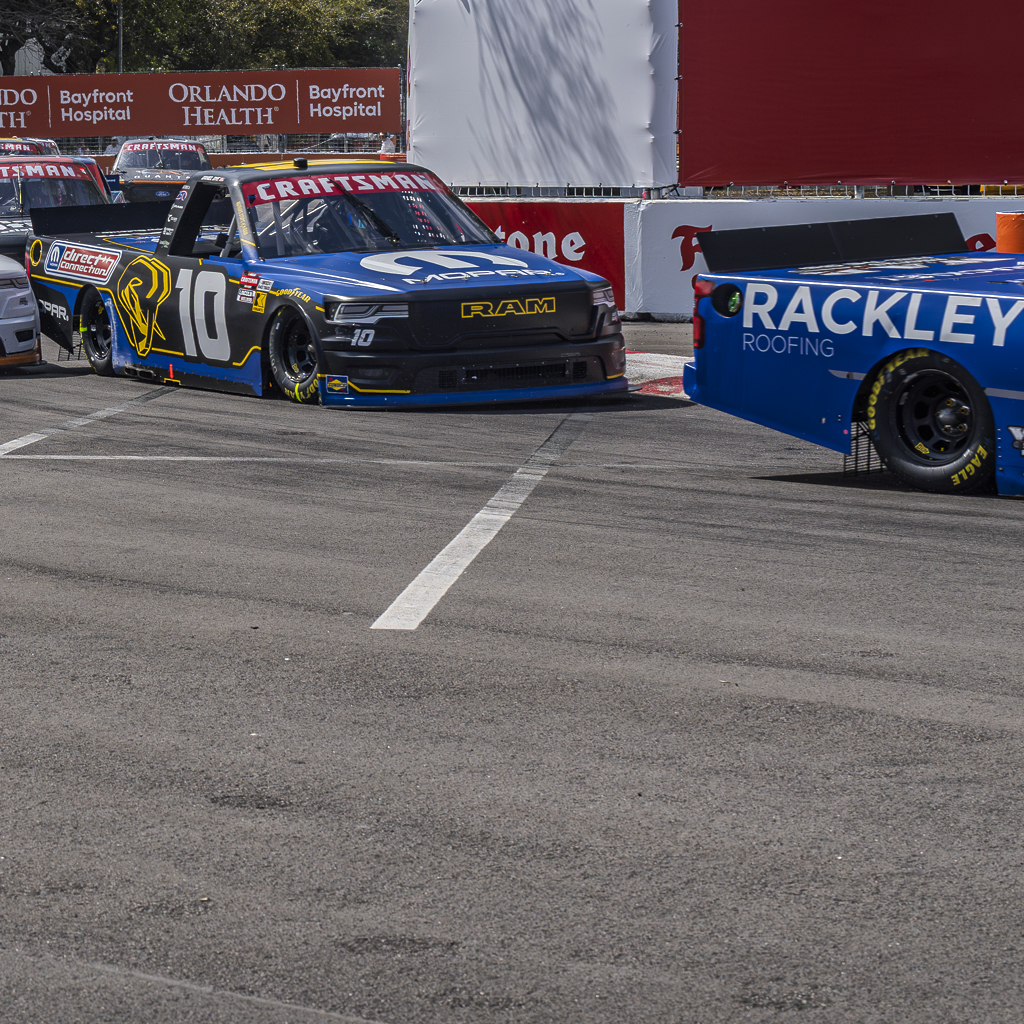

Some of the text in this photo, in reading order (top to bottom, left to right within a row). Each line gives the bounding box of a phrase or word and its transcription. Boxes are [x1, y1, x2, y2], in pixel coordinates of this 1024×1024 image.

[60, 89, 134, 107] Bayfront
[168, 83, 385, 102] ORLANDO Bayfront
[61, 106, 131, 124] Hospital
[309, 102, 381, 120] Hospital
[127, 143, 196, 151] CRAFTSMAN
[257, 173, 436, 201] CRAFTSMAN
[64, 248, 106, 266] direct
[60, 261, 109, 276] connection
[401, 269, 553, 285] MOPAR
[276, 287, 312, 303] GOODYEAR
[175, 268, 231, 362] 10
[461, 297, 556, 319] RAM
[742, 283, 1024, 347] RACKLEY
[351, 328, 375, 347] 10
[743, 332, 835, 358] ROOFING
[950, 444, 989, 487] EAGLE
